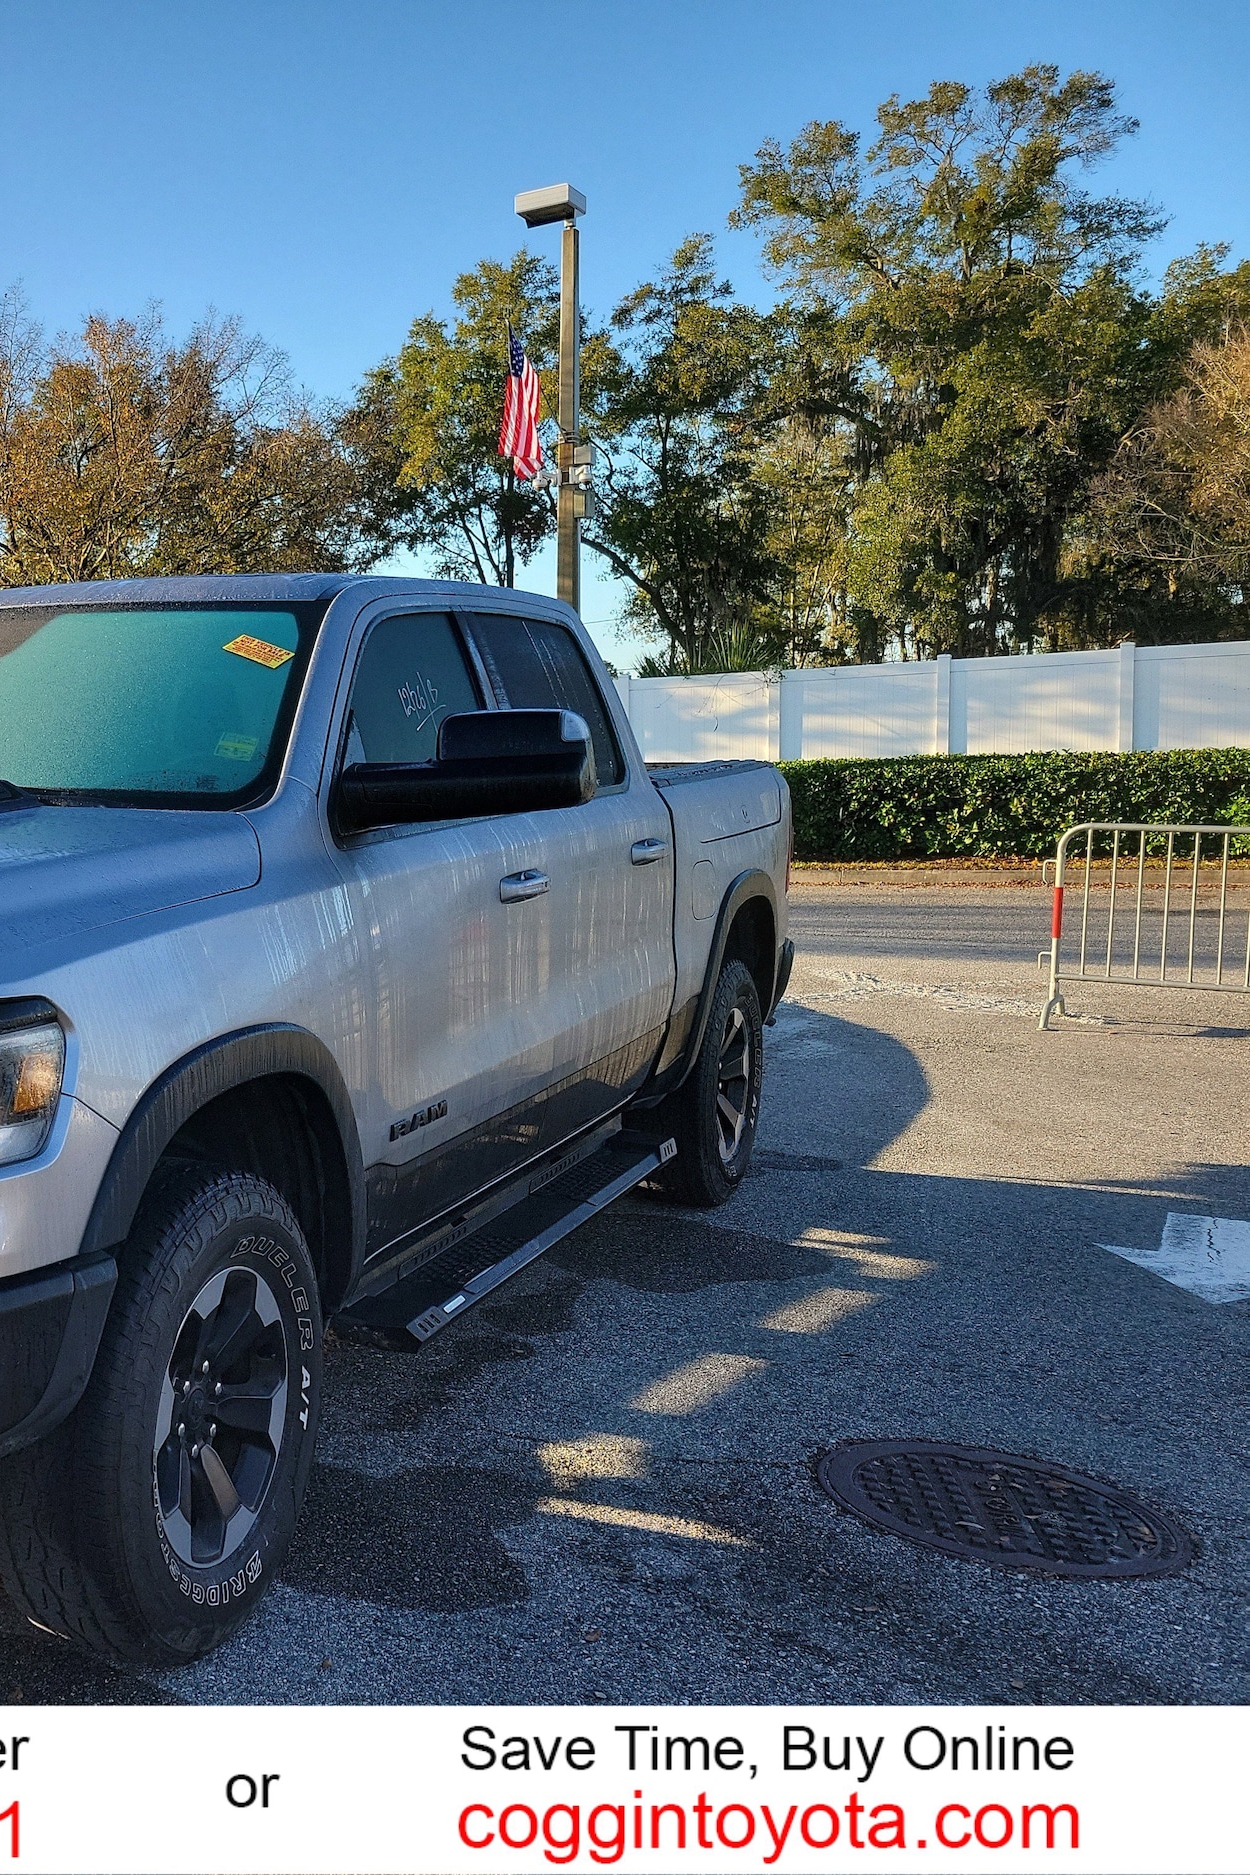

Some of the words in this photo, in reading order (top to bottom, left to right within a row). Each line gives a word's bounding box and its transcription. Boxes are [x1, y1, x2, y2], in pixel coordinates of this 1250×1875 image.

[389, 1099, 448, 1143] RAM
[230, 1236, 315, 1351] DUELER
[299, 1365, 311, 1431] A/T
